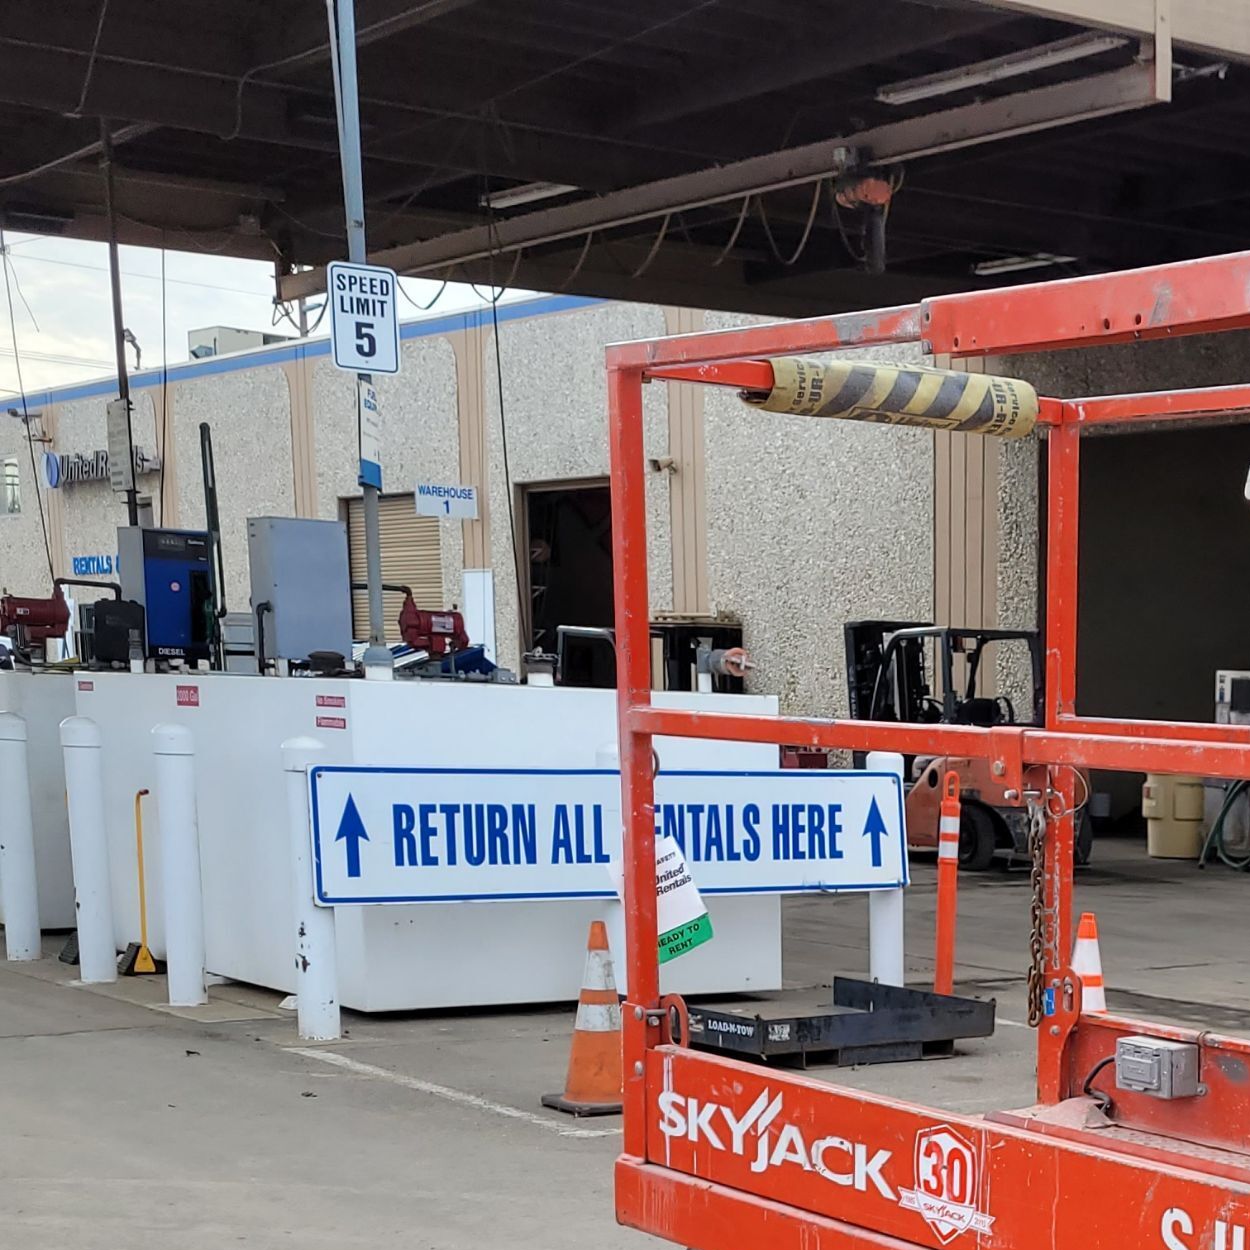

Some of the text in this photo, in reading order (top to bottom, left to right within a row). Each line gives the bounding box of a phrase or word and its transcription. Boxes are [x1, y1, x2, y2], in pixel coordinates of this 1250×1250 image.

[336, 273, 389, 297] SPEED
[340, 295, 388, 318] LIMIT
[355, 321, 377, 358] 5
[60, 450, 99, 481] United
[418, 484, 474, 500] WAREHOUSE
[443, 500, 450, 514] 1
[73, 555, 112, 576] RENTALS
[392, 803, 844, 866] RETURN ALL NTALS HERE
[656, 852, 676, 866] AFETY
[656, 873, 692, 897] Rentals
[688, 923, 700, 935] TO
[668, 938, 693, 955] RENT
[707, 1019, 754, 1037] LOAD-N-TOW
[658, 1087, 898, 1201] SKYJACK
[923, 1140, 967, 1203] 30
